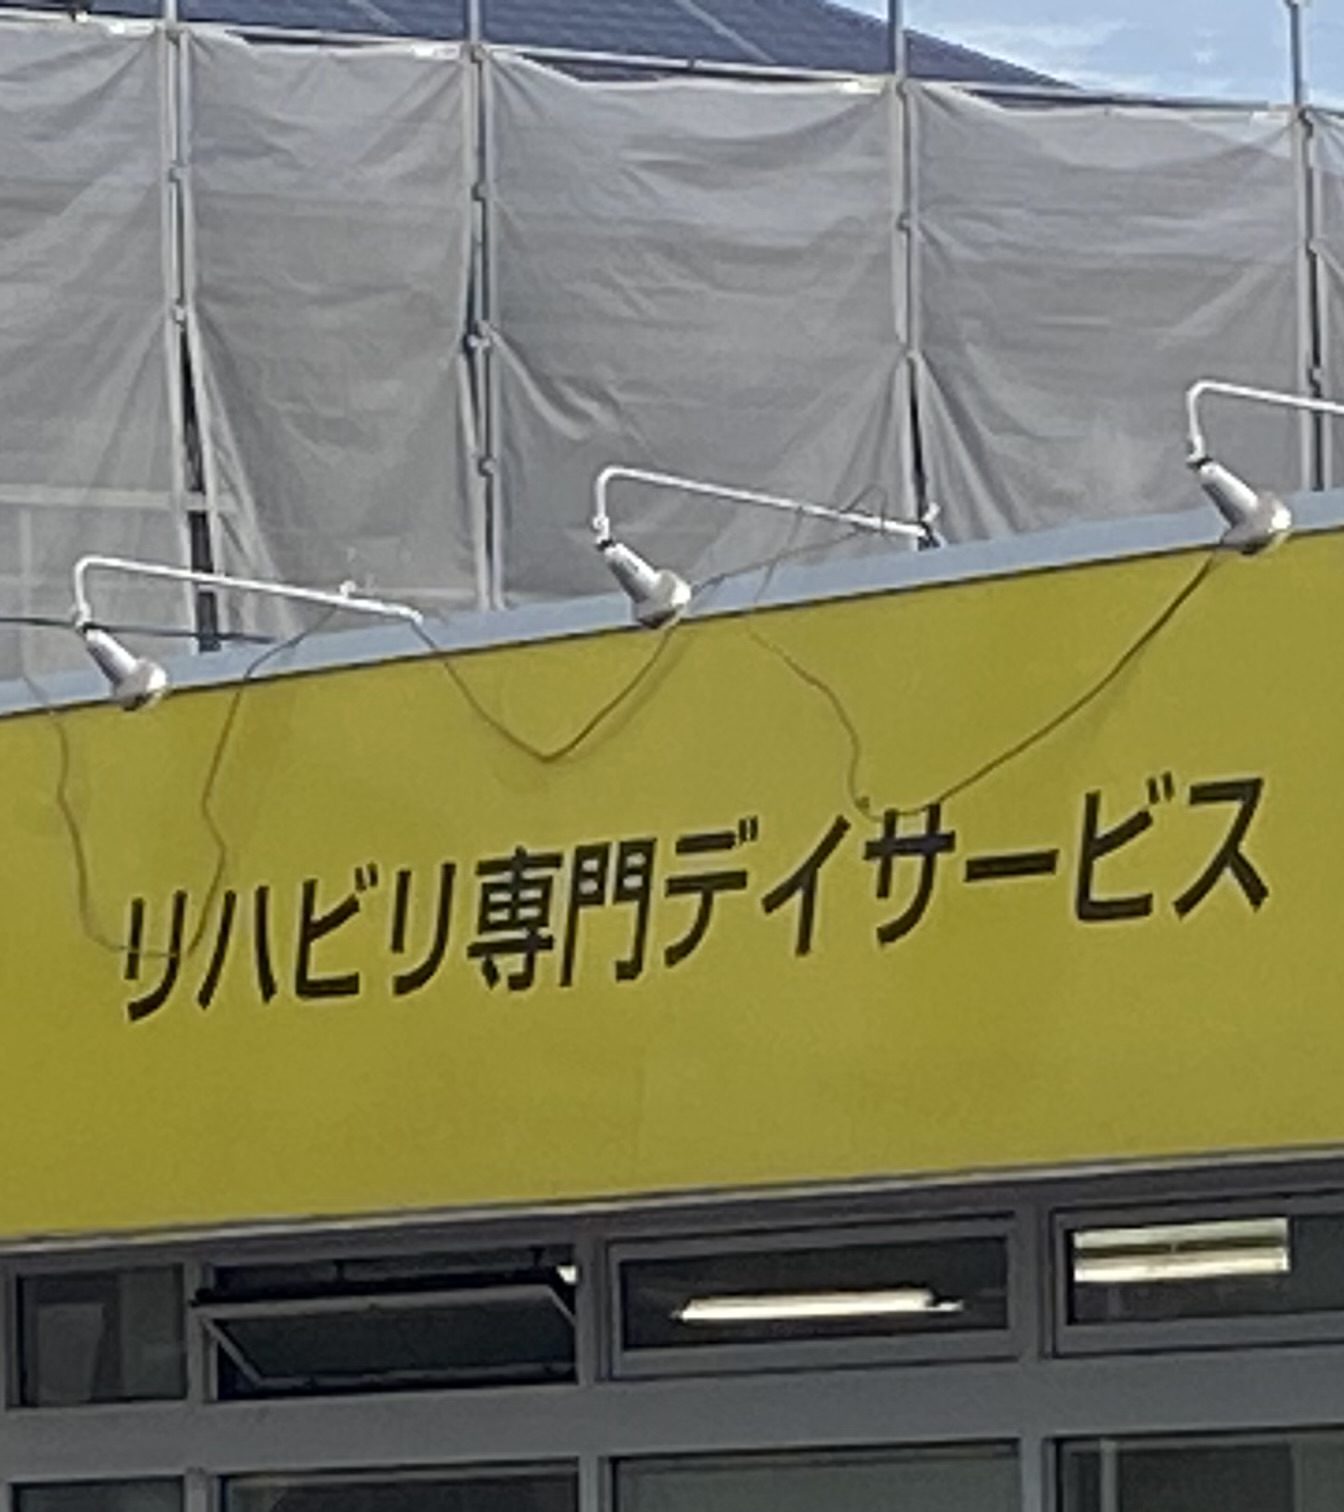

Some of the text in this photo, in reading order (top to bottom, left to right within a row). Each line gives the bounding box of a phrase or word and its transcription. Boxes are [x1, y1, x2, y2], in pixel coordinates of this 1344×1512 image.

[123, 771, 1270, 1022] リハビリ専門デイサービス
